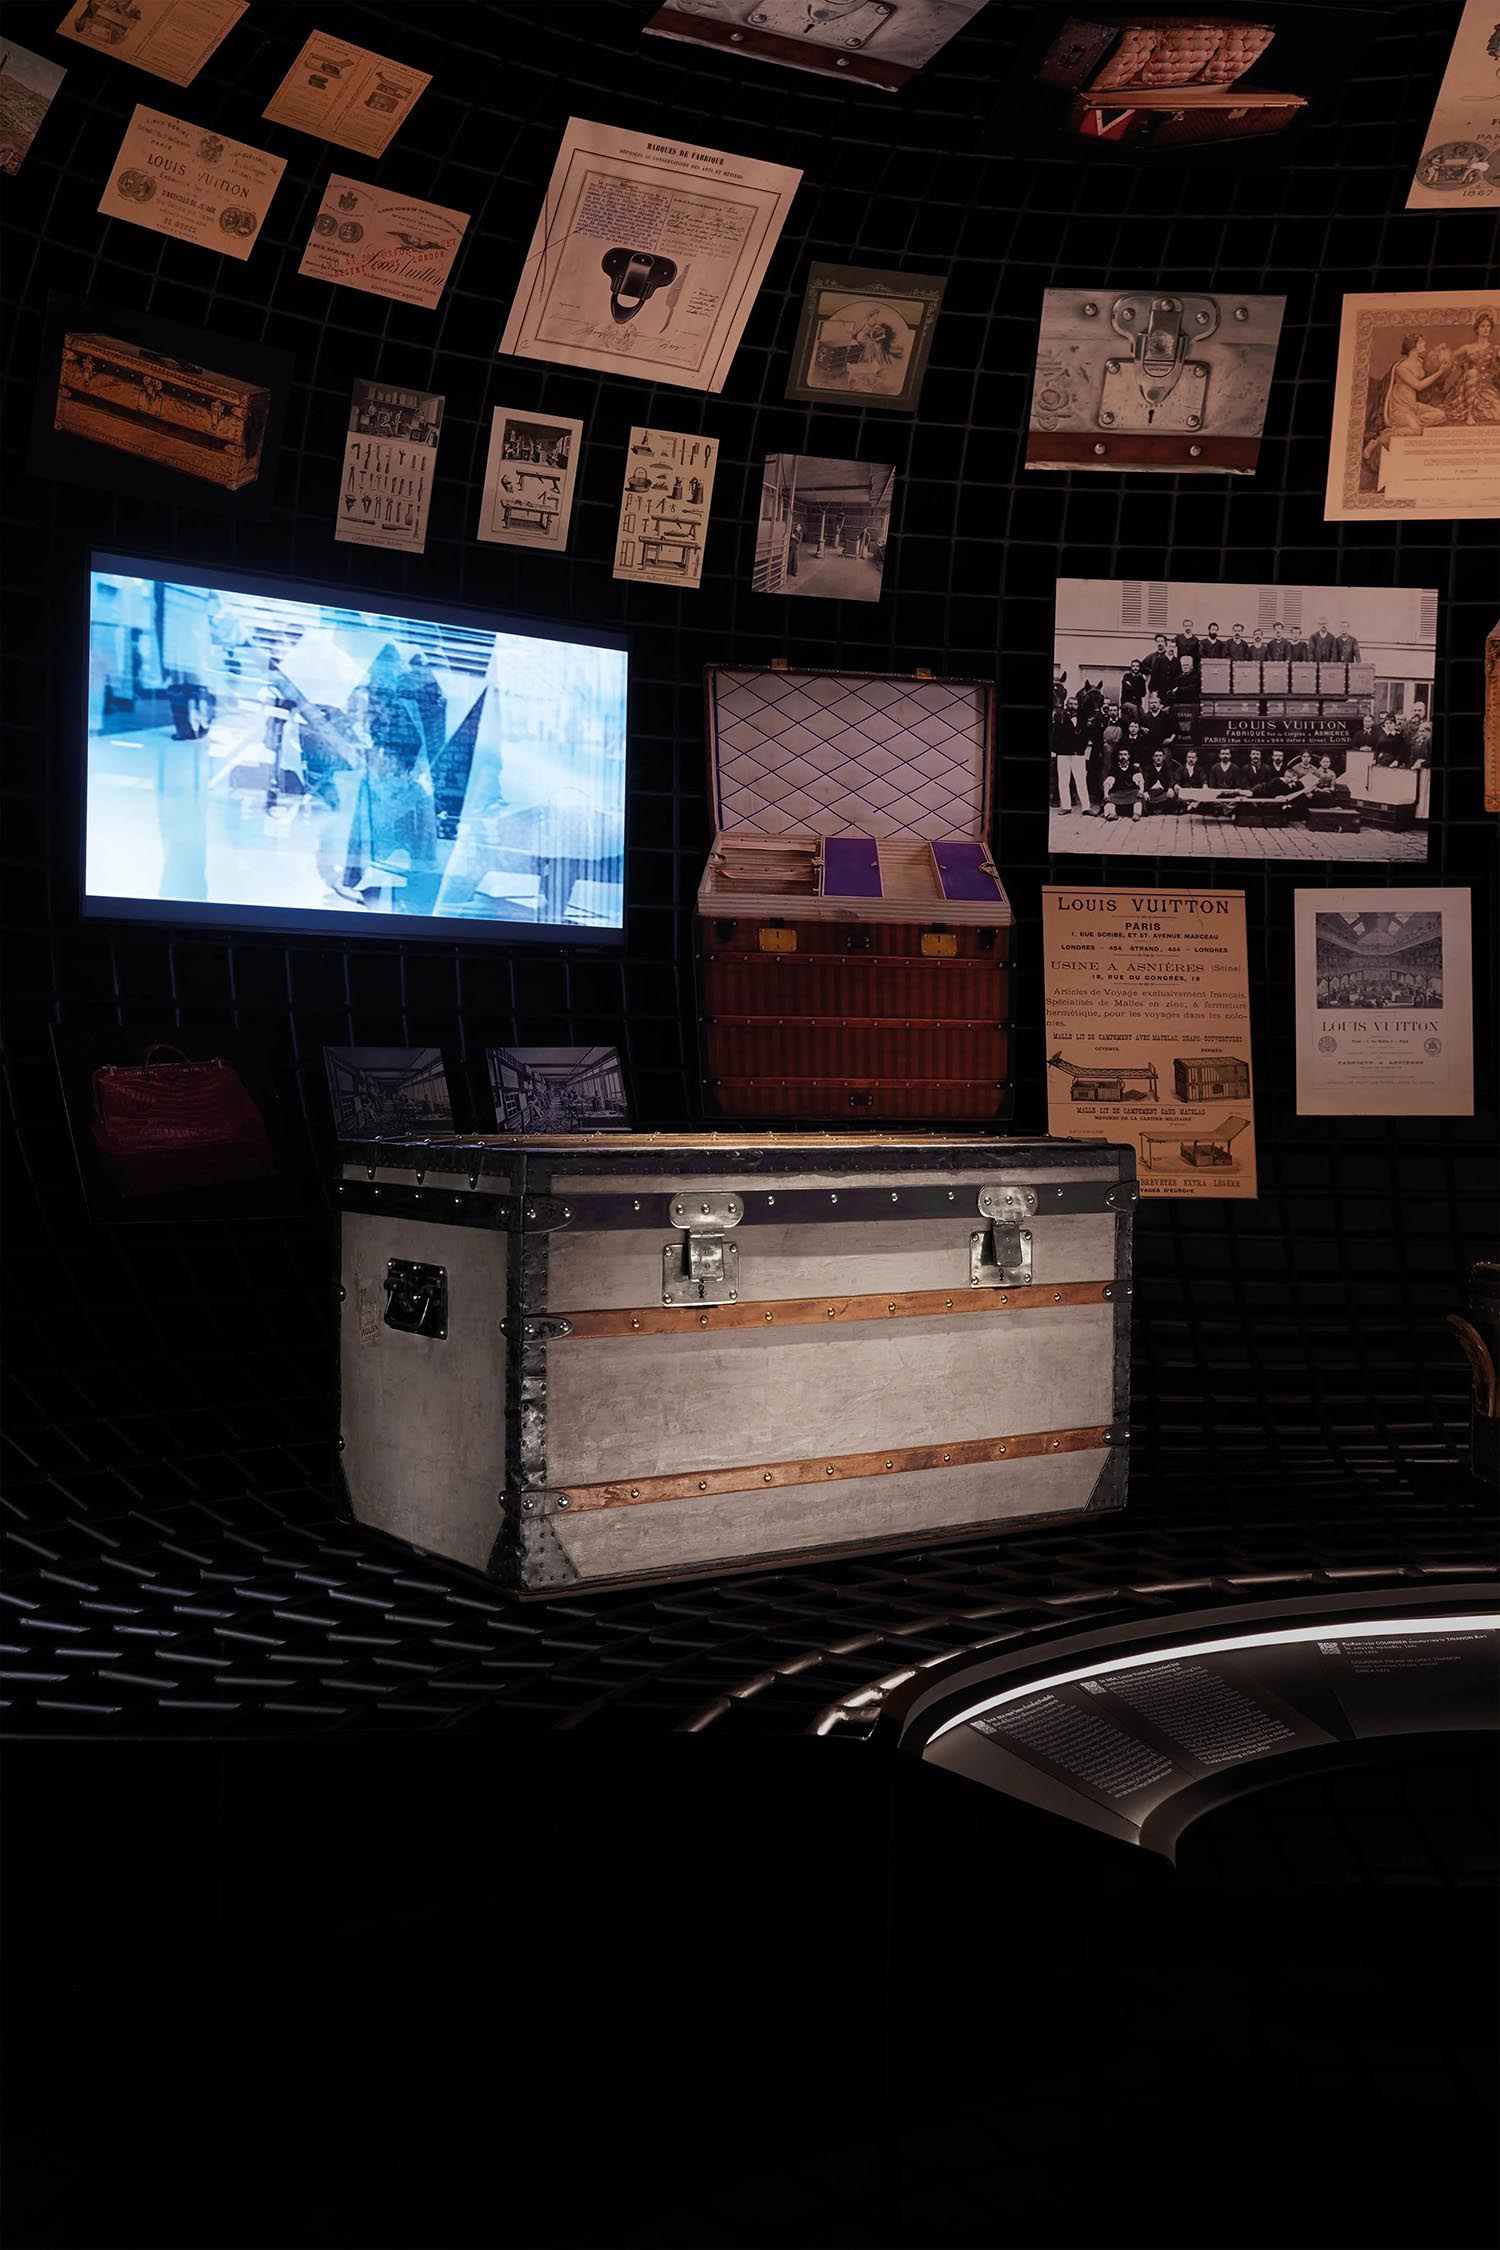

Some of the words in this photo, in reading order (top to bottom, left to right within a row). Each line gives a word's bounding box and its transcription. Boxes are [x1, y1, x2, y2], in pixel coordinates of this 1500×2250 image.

[646, 142, 677, 155] MARQUES
[679, 150, 689, 158] DE
[691, 152, 725, 166] FABRIQUE
[147, 153, 187, 175] LOUIS
[197, 171, 250, 199] VUITTON
[1462, 189, 1494, 197] 1867
[1227, 720, 1277, 730] LOUIS
[1283, 720, 1347, 730] VUITTON
[1204, 736, 1227, 744] PARIS
[1057, 896, 1118, 912] LOUIS
[1131, 898, 1229, 914] VUITTON
[1125, 922, 1161, 931] PARIS
[1050, 961, 1099, 971] USINE
[1107, 962, 1118, 971] A
[1126, 961, 1205, 973] ASNIÈRES
[1054, 988, 1088, 996] Articles
[1103, 988, 1138, 997] Voyage
[1142, 989, 1206, 998] exclusivement
[1046, 998, 1094, 1006] Spécialités
[1114, 999, 1144, 1007] Malles
[1204, 1001, 1248, 1010] fermeture
[1046, 1009, 1101, 1018] hermétique,
[1104, 1010, 1126, 1018] pour
[1144, 1011, 1180, 1019] voyages
[1183, 1011, 1206, 1019] dans
[1208, 1011, 1222, 1019] les
[1224, 1012, 1248, 1020] colo-
[1046, 1019, 1067, 1027] nies.
[1322, 1021, 1367, 1032] LOUIS
[1373, 1021, 1439, 1032] VUITTON
[1183, 1179, 1207, 1187] EXTRA
